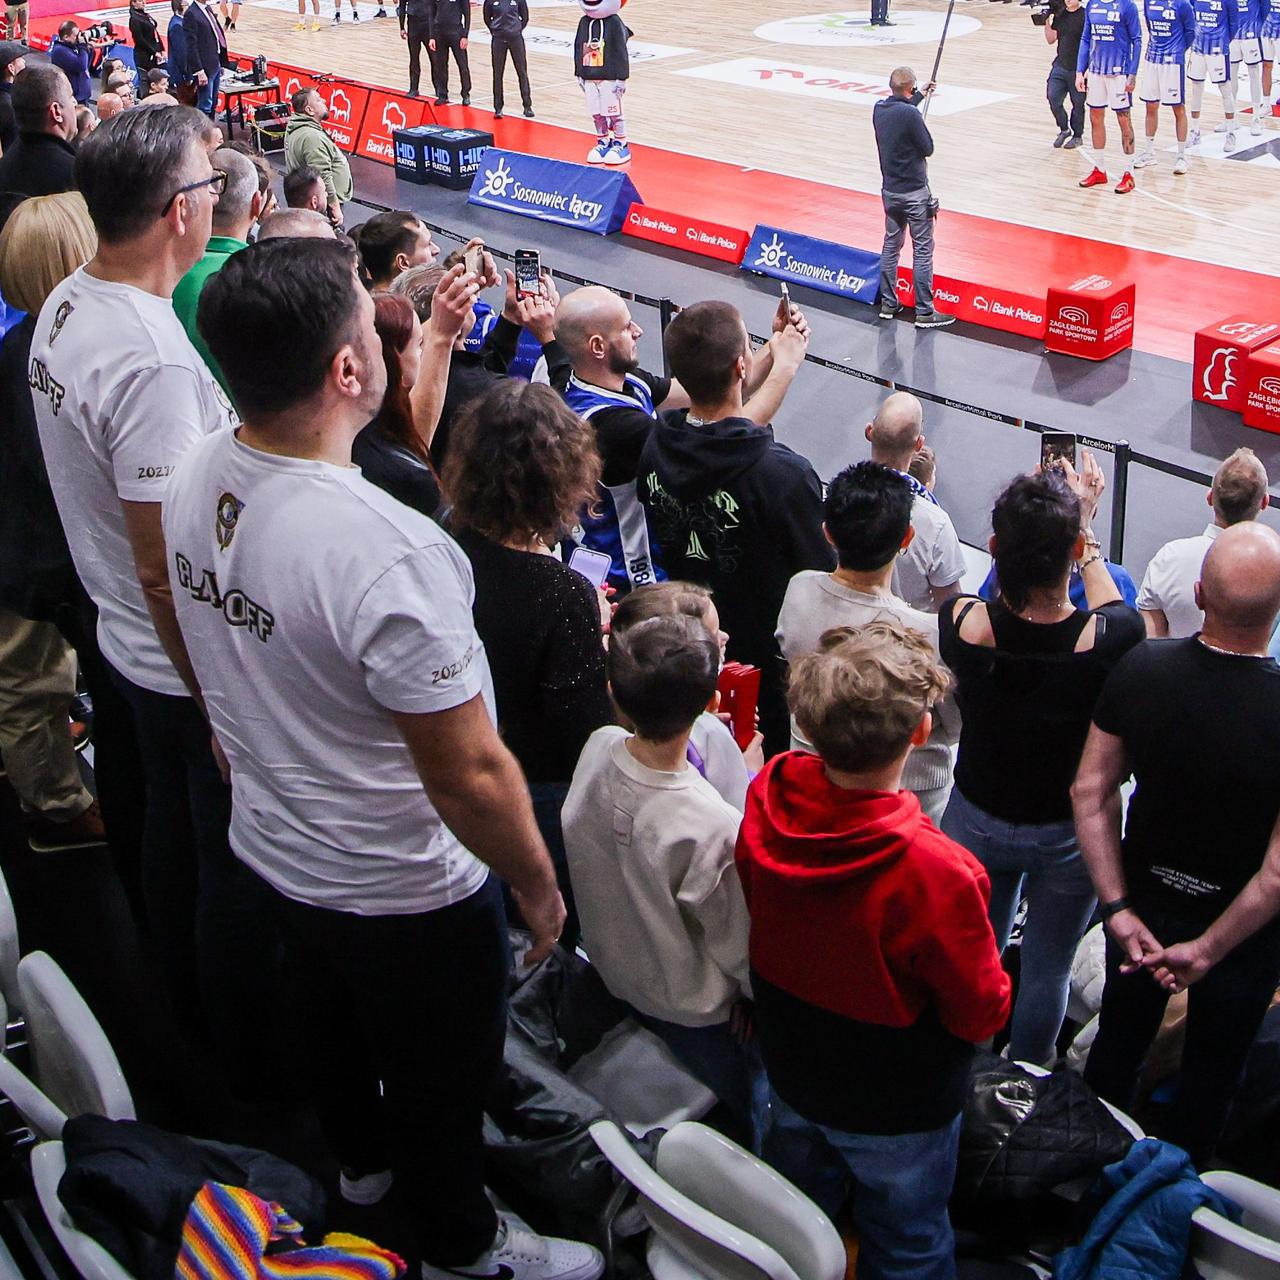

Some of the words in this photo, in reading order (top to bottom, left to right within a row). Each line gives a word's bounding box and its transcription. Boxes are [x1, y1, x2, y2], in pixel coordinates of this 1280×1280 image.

[365, 139, 384, 156] Bank
[396, 141, 415, 160] HID
[431, 147, 451, 165] HID
[396, 156, 417, 168] RATION
[432, 161, 452, 173] RATION
[459, 162, 481, 174] RATI
[510, 181, 569, 211] Sosnowiec
[569, 193, 603, 223] łączy
[642, 217, 658, 230] Bank
[658, 220, 677, 235] Pekao
[700, 232, 716, 245] Bank
[716, 235, 737, 250] Pekao
[784, 255, 837, 283] Sosnowiec
[836, 267, 866, 294] łączy
[935, 289, 960, 304] Pekao
[992, 302, 1014, 317] Bank
[1015, 307, 1043, 324] Pekao
[1048, 327, 1064, 336] PARK
[1064, 330, 1097, 343] SPORTOWY
[1049, 319, 1098, 336] ZAGŁĘBIOWSKI
[1247, 400, 1264, 409] PARK
[1082, 437, 1115, 453] ArcelorM
